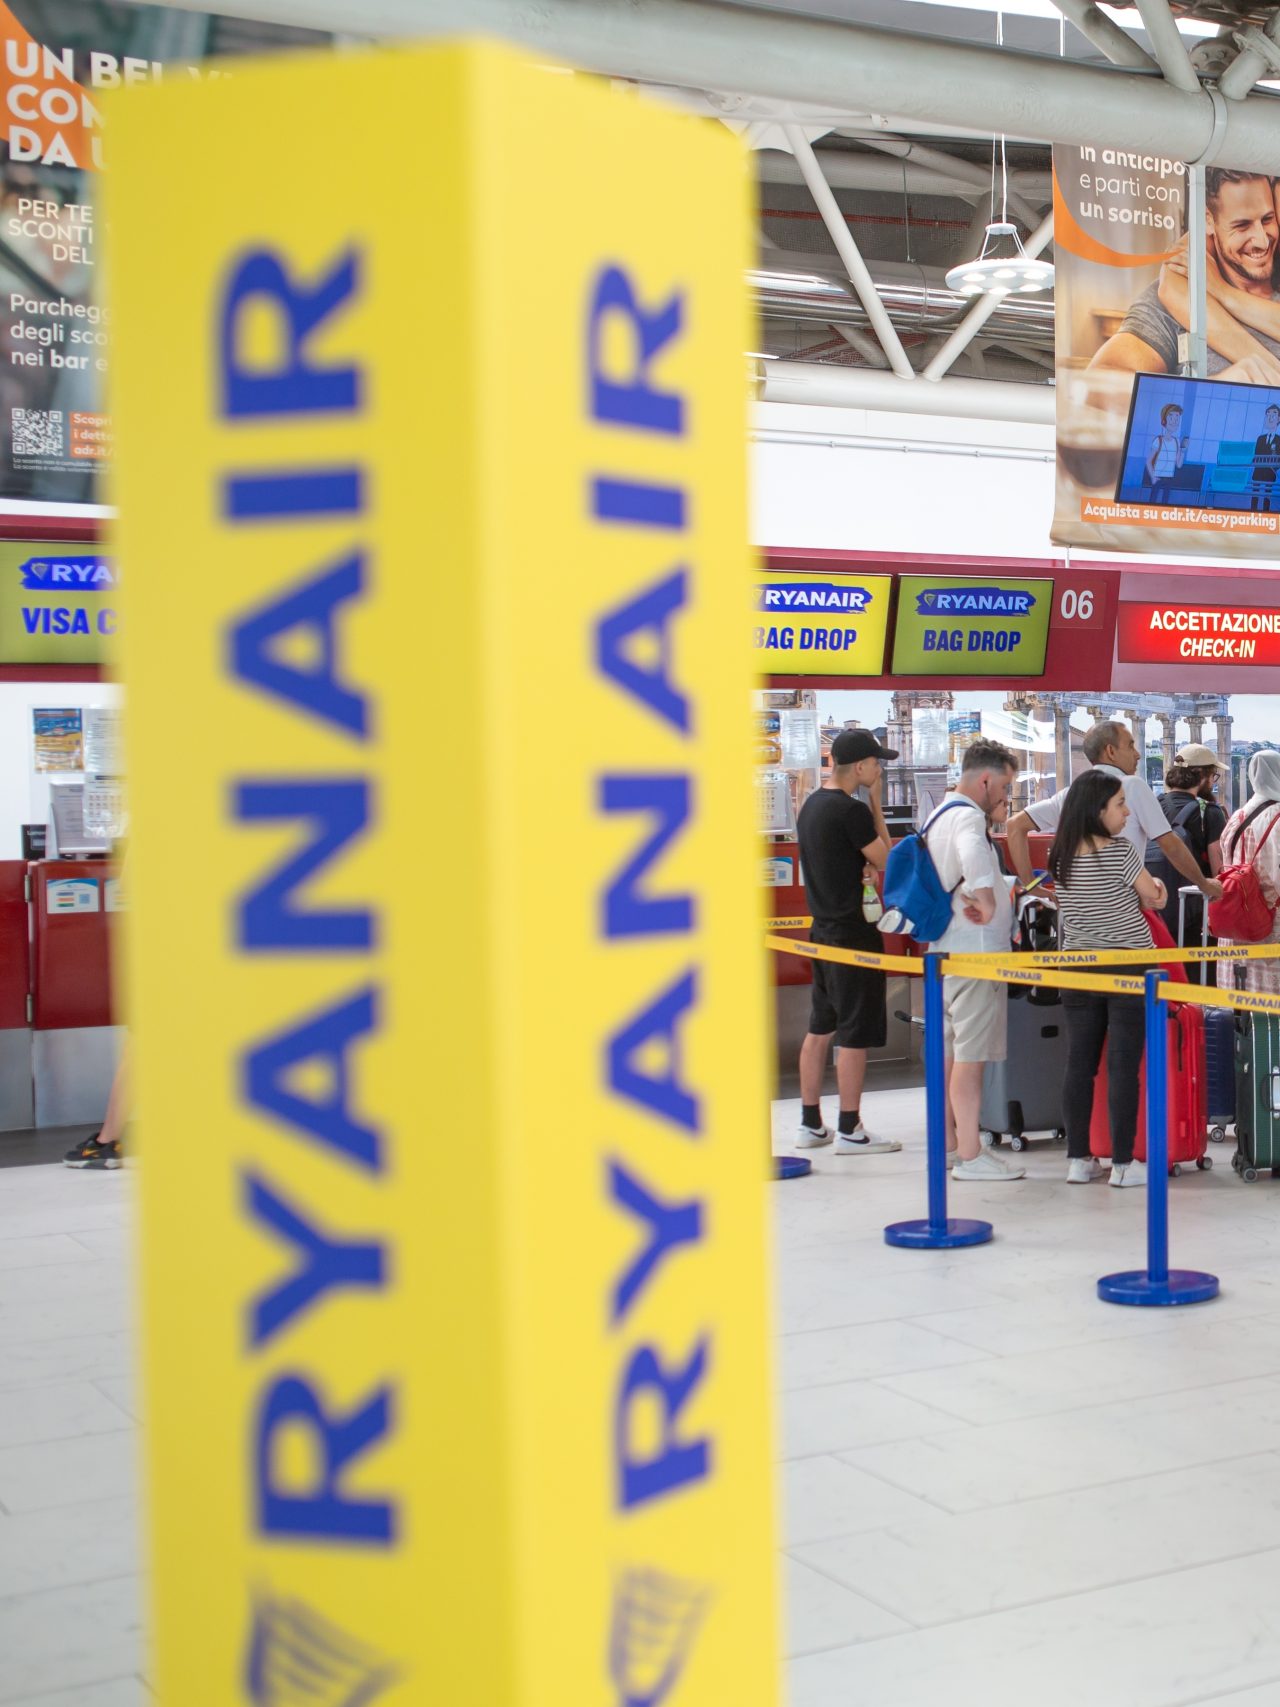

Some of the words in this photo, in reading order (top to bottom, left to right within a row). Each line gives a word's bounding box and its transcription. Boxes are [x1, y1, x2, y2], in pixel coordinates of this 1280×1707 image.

[5, 39, 74, 84] UN
[9, 124, 78, 168] DA
[1080, 146, 1096, 162] in
[1102, 149, 1185, 178] anticipo
[1080, 173, 1090, 188] e
[1095, 176, 1140, 197] parti
[1145, 185, 1180, 203] con
[18, 198, 59, 219] PER
[64, 203, 94, 223] TE
[1080, 202, 1103, 220] un
[1108, 206, 1175, 230] sorriso
[8, 218, 94, 244] SCONTI
[52, 243, 94, 265] DEL
[10, 320, 65, 346] degli
[70, 330, 109, 345] sco
[11, 349, 44, 367] nei
[50, 349, 89, 370] bar
[1084, 503, 1140, 522] Acquista
[1143, 509, 1158, 520] su
[1161, 508, 1277, 531] adr.it/easyparking
[765, 589, 865, 608] RYANAIR
[937, 594, 1029, 611] RYANAIR
[1060, 590, 1094, 620] 06
[22, 608, 90, 634] VISA
[752, 628, 794, 650] BAG
[799, 628, 857, 651] DROP
[923, 629, 963, 652] BAG
[968, 630, 1021, 652] DROP
[1179, 637, 1256, 658] CHECK-IN
[219, 242, 398, 1552] RYANAIR
[587, 259, 714, 1514] RYANAIR
[767, 919, 803, 927] YANAIR
[1042, 953, 1097, 965] RYANAIR
[1197, 948, 1249, 959] RYANAIR
[1002, 968, 1042, 982] RYANAIR
